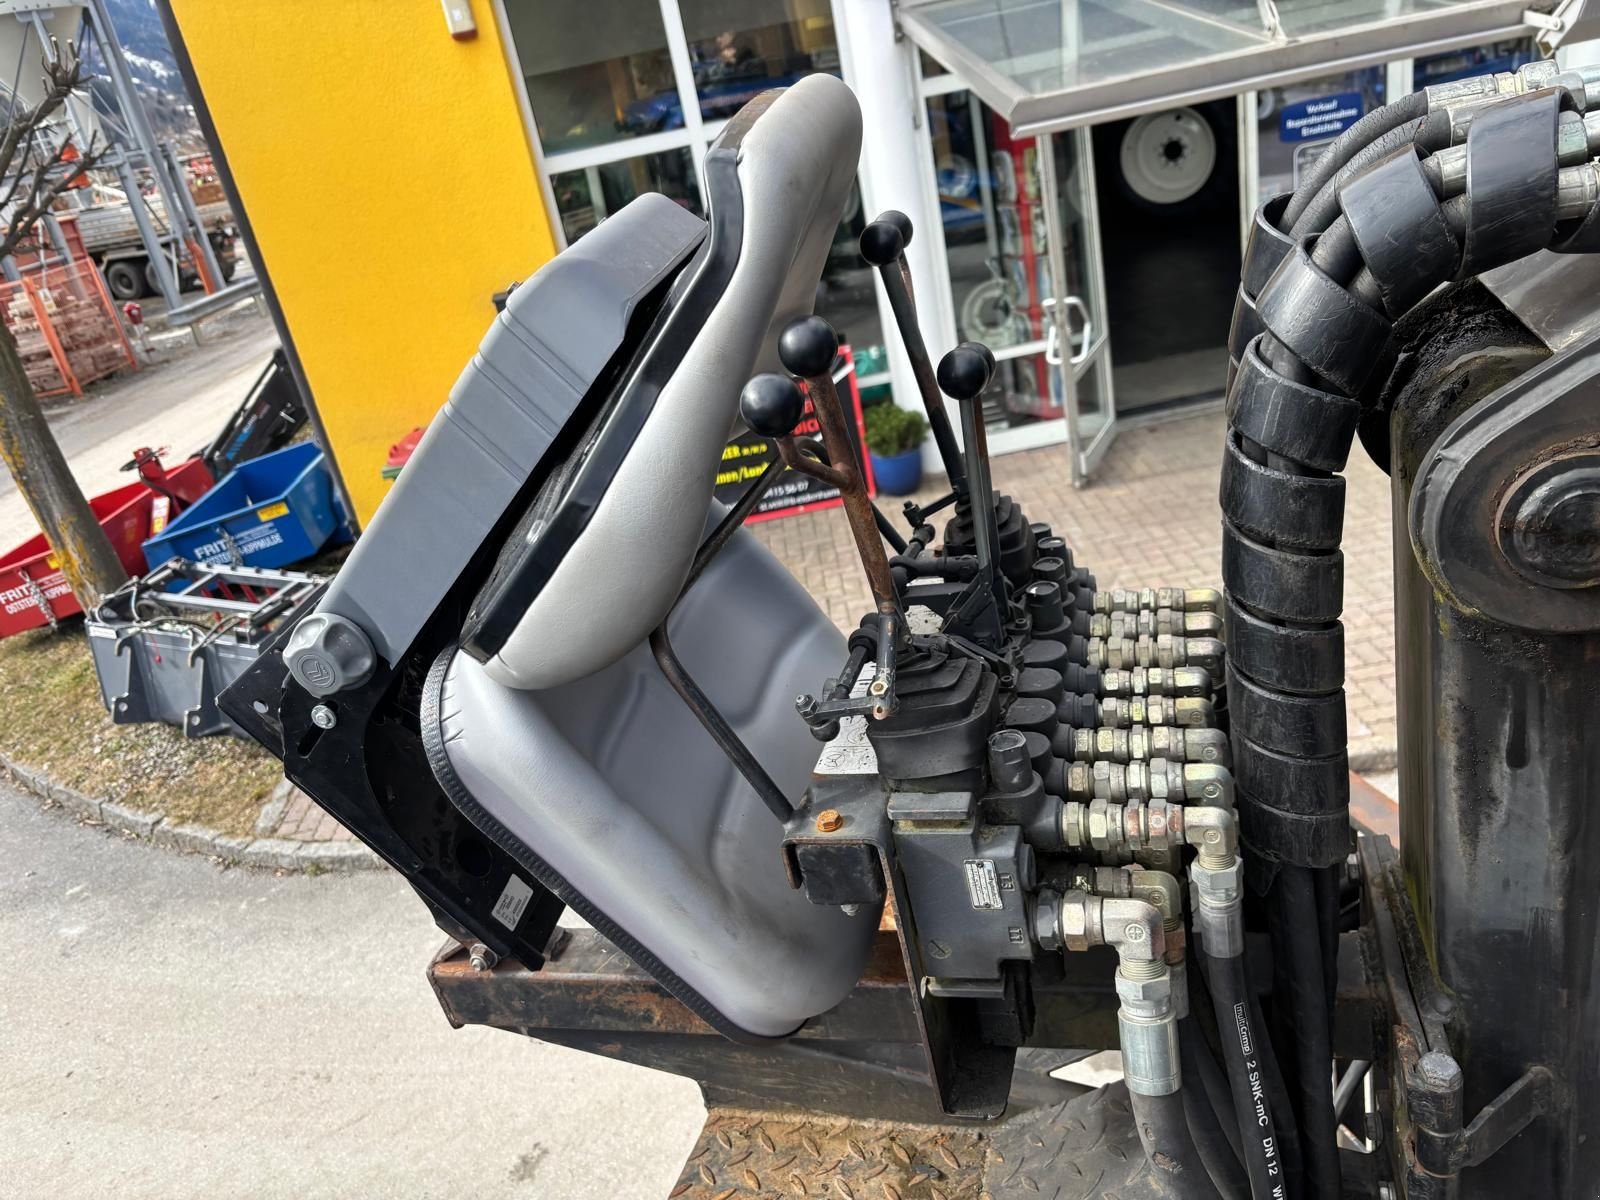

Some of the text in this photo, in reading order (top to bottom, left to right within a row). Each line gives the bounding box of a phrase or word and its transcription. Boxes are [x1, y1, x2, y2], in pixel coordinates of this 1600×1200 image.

[1236, 1006, 1251, 1052] multiCrimp
[1246, 1060, 1257, 1070] 2
[1249, 1071, 1269, 1127] SNK-mC
[1263, 1136, 1275, 1158] DN
[1268, 1160, 1279, 1176] 12
